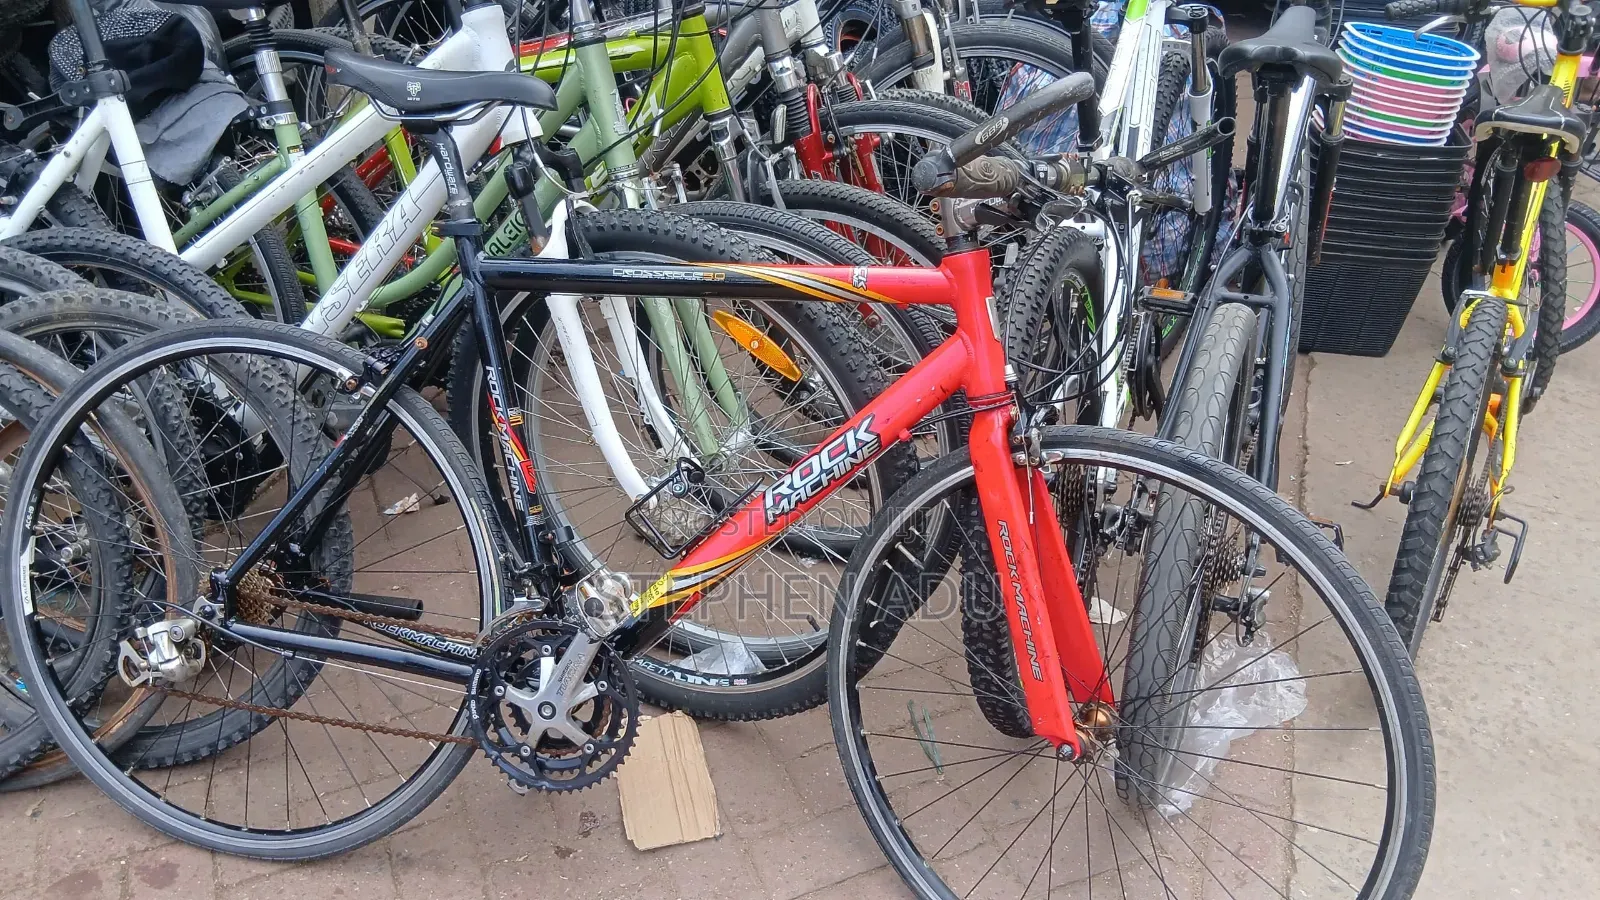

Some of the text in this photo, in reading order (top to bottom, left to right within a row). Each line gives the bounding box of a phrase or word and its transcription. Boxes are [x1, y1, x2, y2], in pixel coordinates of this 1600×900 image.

[436, 142, 459, 195] Hardware
[485, 365, 506, 423] ROCK
[498, 423, 525, 512] MACHINE
[764, 412, 880, 509] ROCK
[766, 437, 881, 525] MACHINE
[997, 519, 1044, 683] ROCK MACHINE
